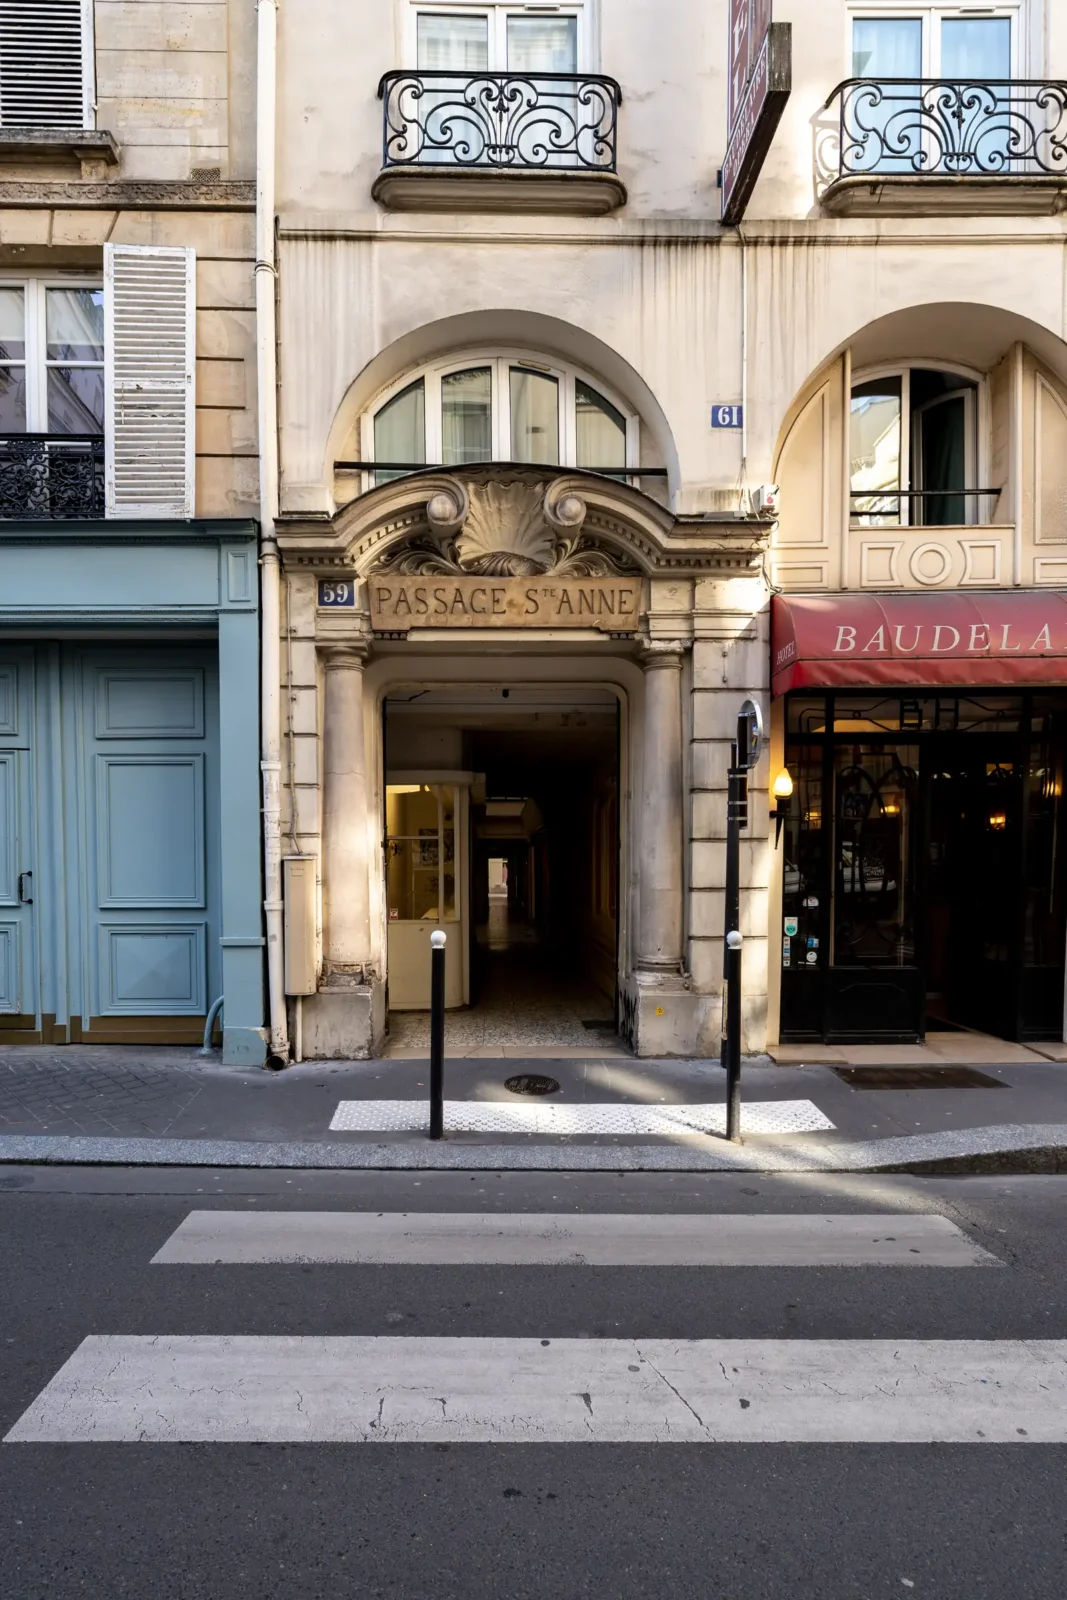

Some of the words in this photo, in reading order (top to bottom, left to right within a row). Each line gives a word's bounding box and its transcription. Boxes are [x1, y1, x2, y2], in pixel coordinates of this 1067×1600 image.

[717, 406, 739, 426] 61
[323, 583, 349, 603] 59
[376, 587, 507, 615] PASSAGE
[556, 588, 634, 615] ANNE
[832, 623, 1067, 652] BAUDELA
[776, 640, 795, 666] HOTEL
